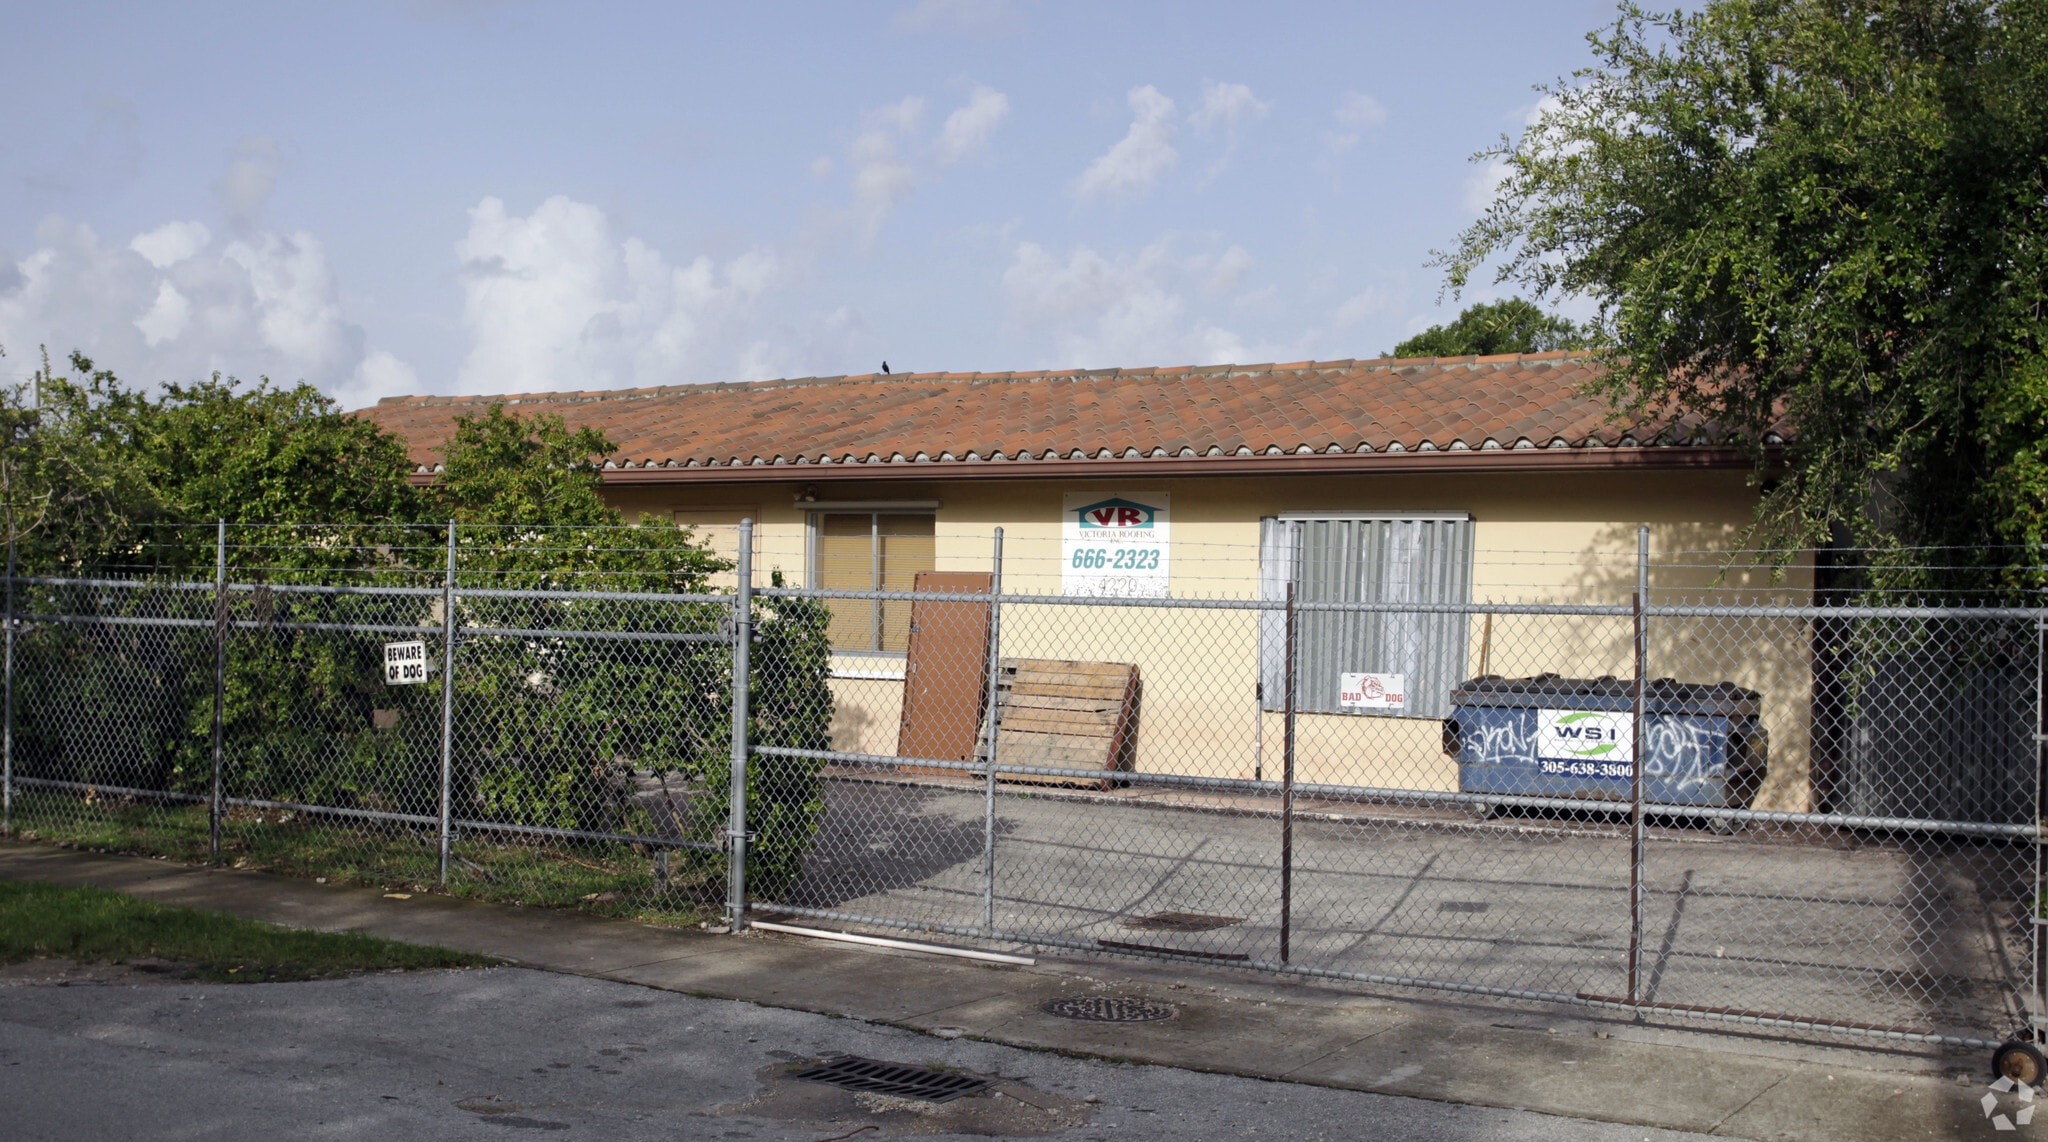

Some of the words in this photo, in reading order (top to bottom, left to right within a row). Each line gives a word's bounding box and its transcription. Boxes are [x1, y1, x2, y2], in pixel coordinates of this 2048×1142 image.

[1091, 507, 1142, 526] VR
[1079, 530, 1117, 538] VICTORIA
[1119, 530, 1155, 538] ROOFING
[1072, 548, 1160, 570] 666-2323
[388, 646, 421, 661] BEWARE
[389, 666, 399, 680] OF
[403, 664, 423, 679] DOG
[1342, 692, 1361, 701] BAD
[1385, 693, 1403, 702] DOG
[1555, 726, 1615, 741] WSI
[1541, 761, 1633, 777] 305-638-3800
